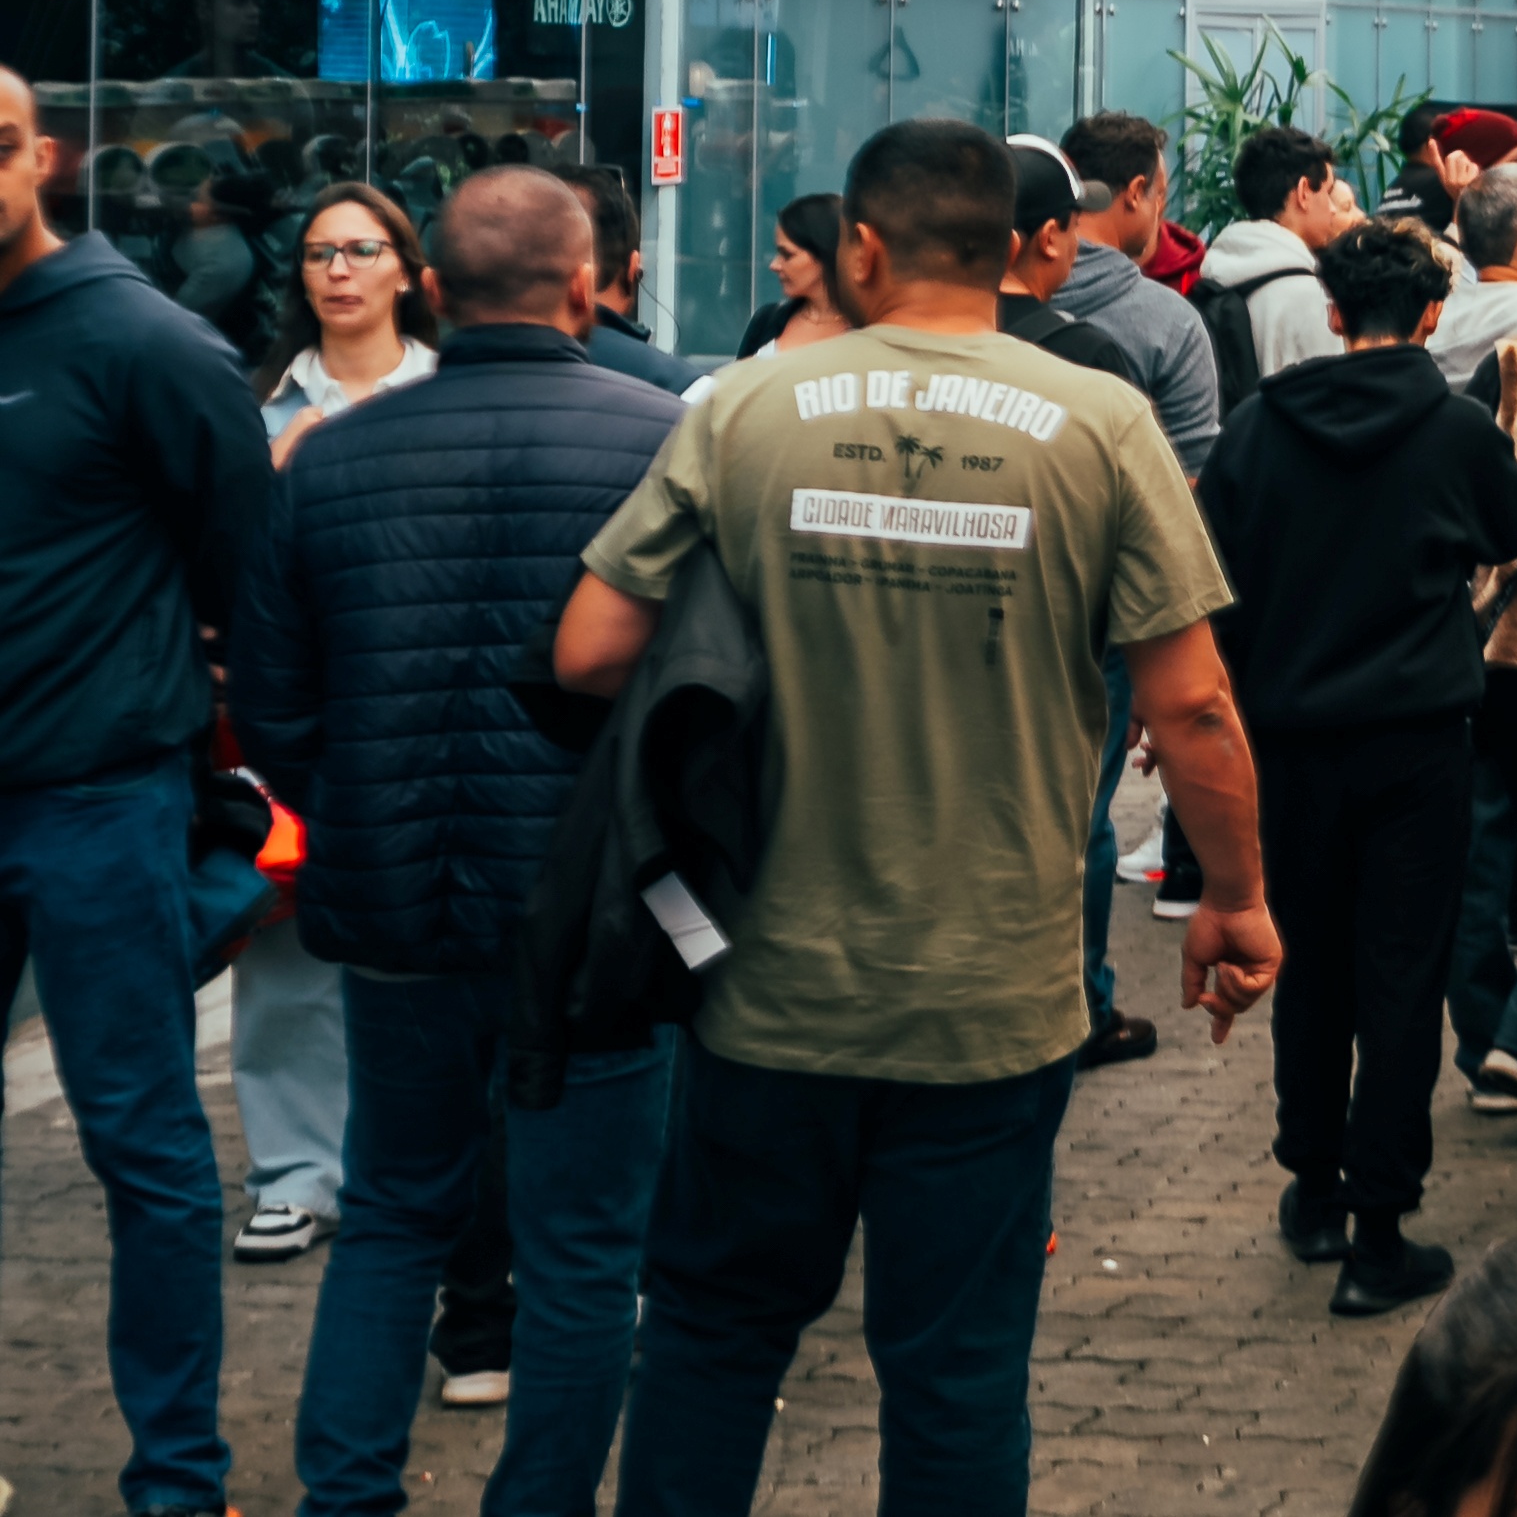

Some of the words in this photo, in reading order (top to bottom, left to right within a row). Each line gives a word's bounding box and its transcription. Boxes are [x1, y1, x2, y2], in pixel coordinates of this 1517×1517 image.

[793, 371, 859, 421] RIO
[866, 370, 912, 409] DE
[914, 373, 1066, 442] JANEIRO
[960, 454, 1005, 473] 1987
[801, 496, 873, 529] CIDADE
[880, 501, 1019, 540] MARAVILHOSA
